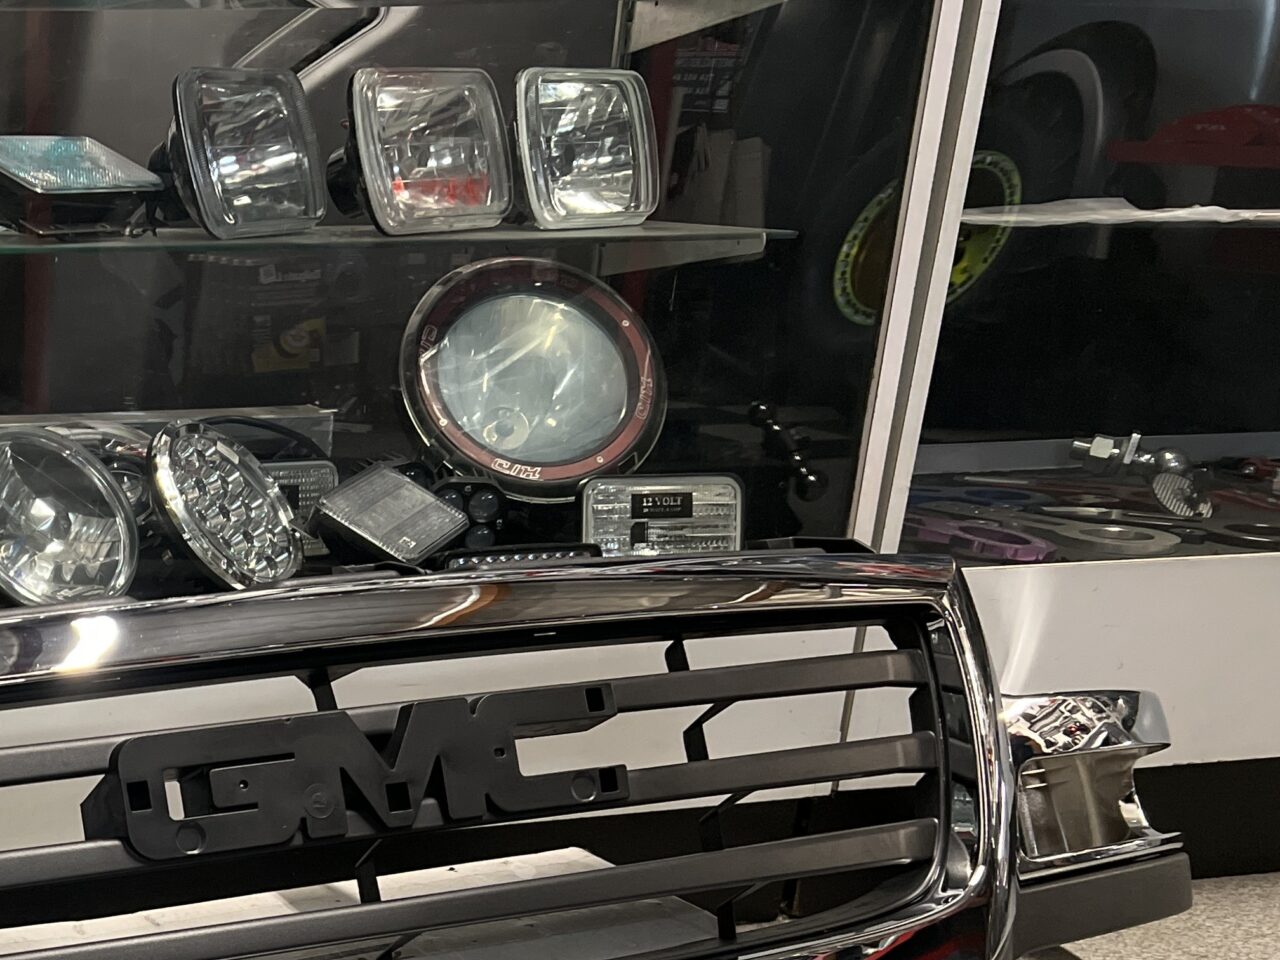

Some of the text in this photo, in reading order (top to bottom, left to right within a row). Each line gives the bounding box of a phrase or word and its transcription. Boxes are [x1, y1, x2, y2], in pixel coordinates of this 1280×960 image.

[642, 496, 683, 506] 12 VOLT
[119, 682, 629, 861] GMC
